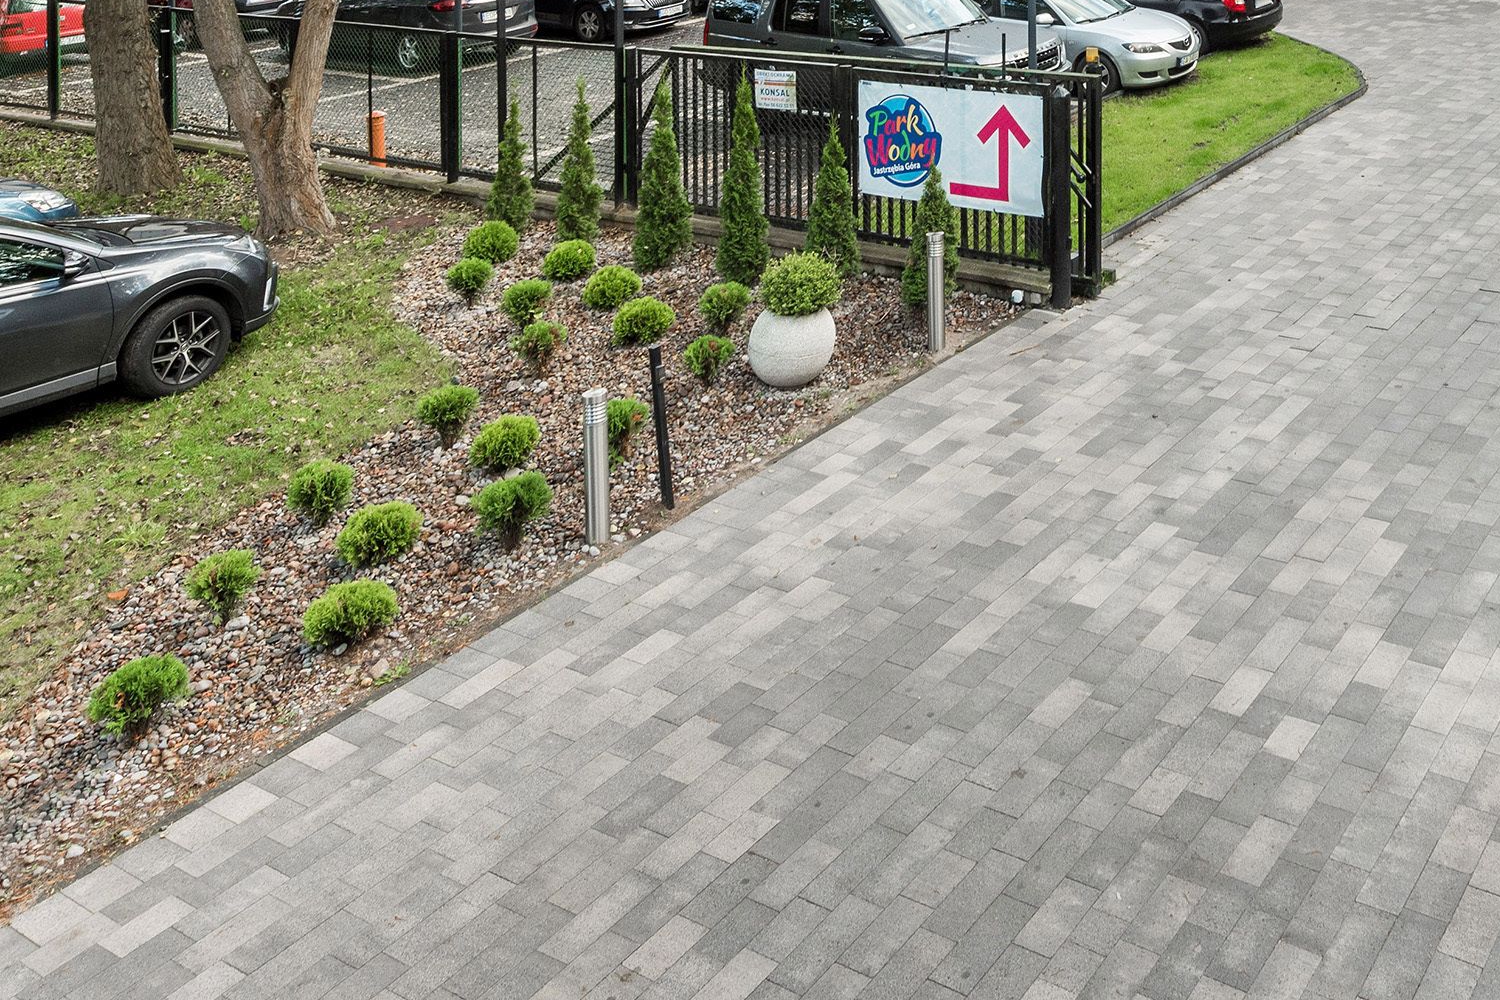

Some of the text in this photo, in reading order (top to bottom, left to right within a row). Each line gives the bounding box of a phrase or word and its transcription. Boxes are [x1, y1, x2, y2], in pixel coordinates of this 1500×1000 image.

[760, 88, 790, 97] KONSAL
[869, 104, 924, 137] Park
[866, 129, 937, 167] Wodny
[873, 161, 921, 175] Jastrzębia Góra
